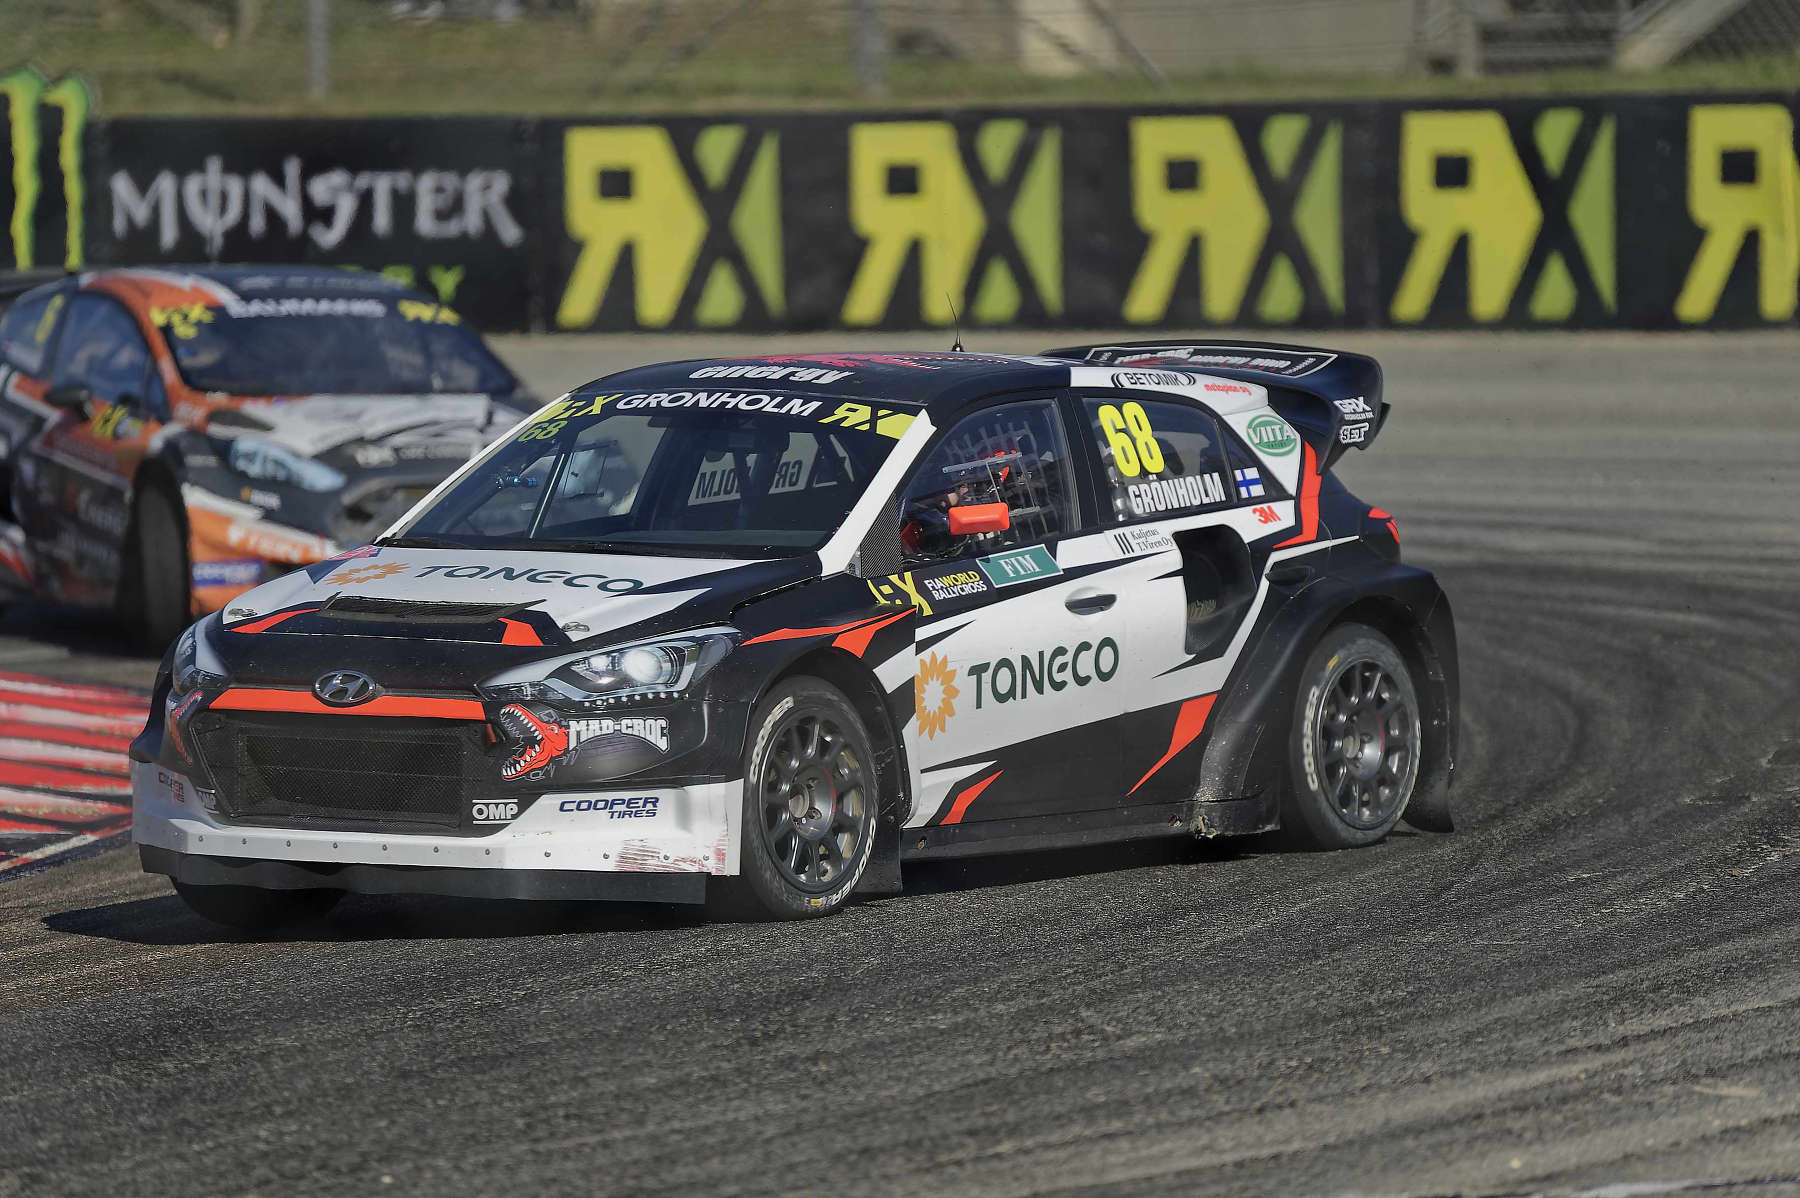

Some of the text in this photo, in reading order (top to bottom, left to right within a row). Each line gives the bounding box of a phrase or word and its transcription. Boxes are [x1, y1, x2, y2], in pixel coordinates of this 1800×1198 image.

[109, 154, 524, 258] MONSTER
[688, 364, 855, 385] energy
[1127, 371, 1184, 387] BETOMIK
[616, 392, 823, 417] GRONHOLM
[518, 420, 568, 443] 68
[1098, 401, 1165, 477] 68
[1247, 424, 1297, 445] VIITA
[1252, 505, 1281, 524] 3M
[931, 580, 988, 601] RALLYCROSS
[568, 717, 670, 754] MAD-CROC
[472, 803, 519, 820] OMP
[559, 796, 660, 812] COOPER
[608, 809, 657, 820] TIRES
